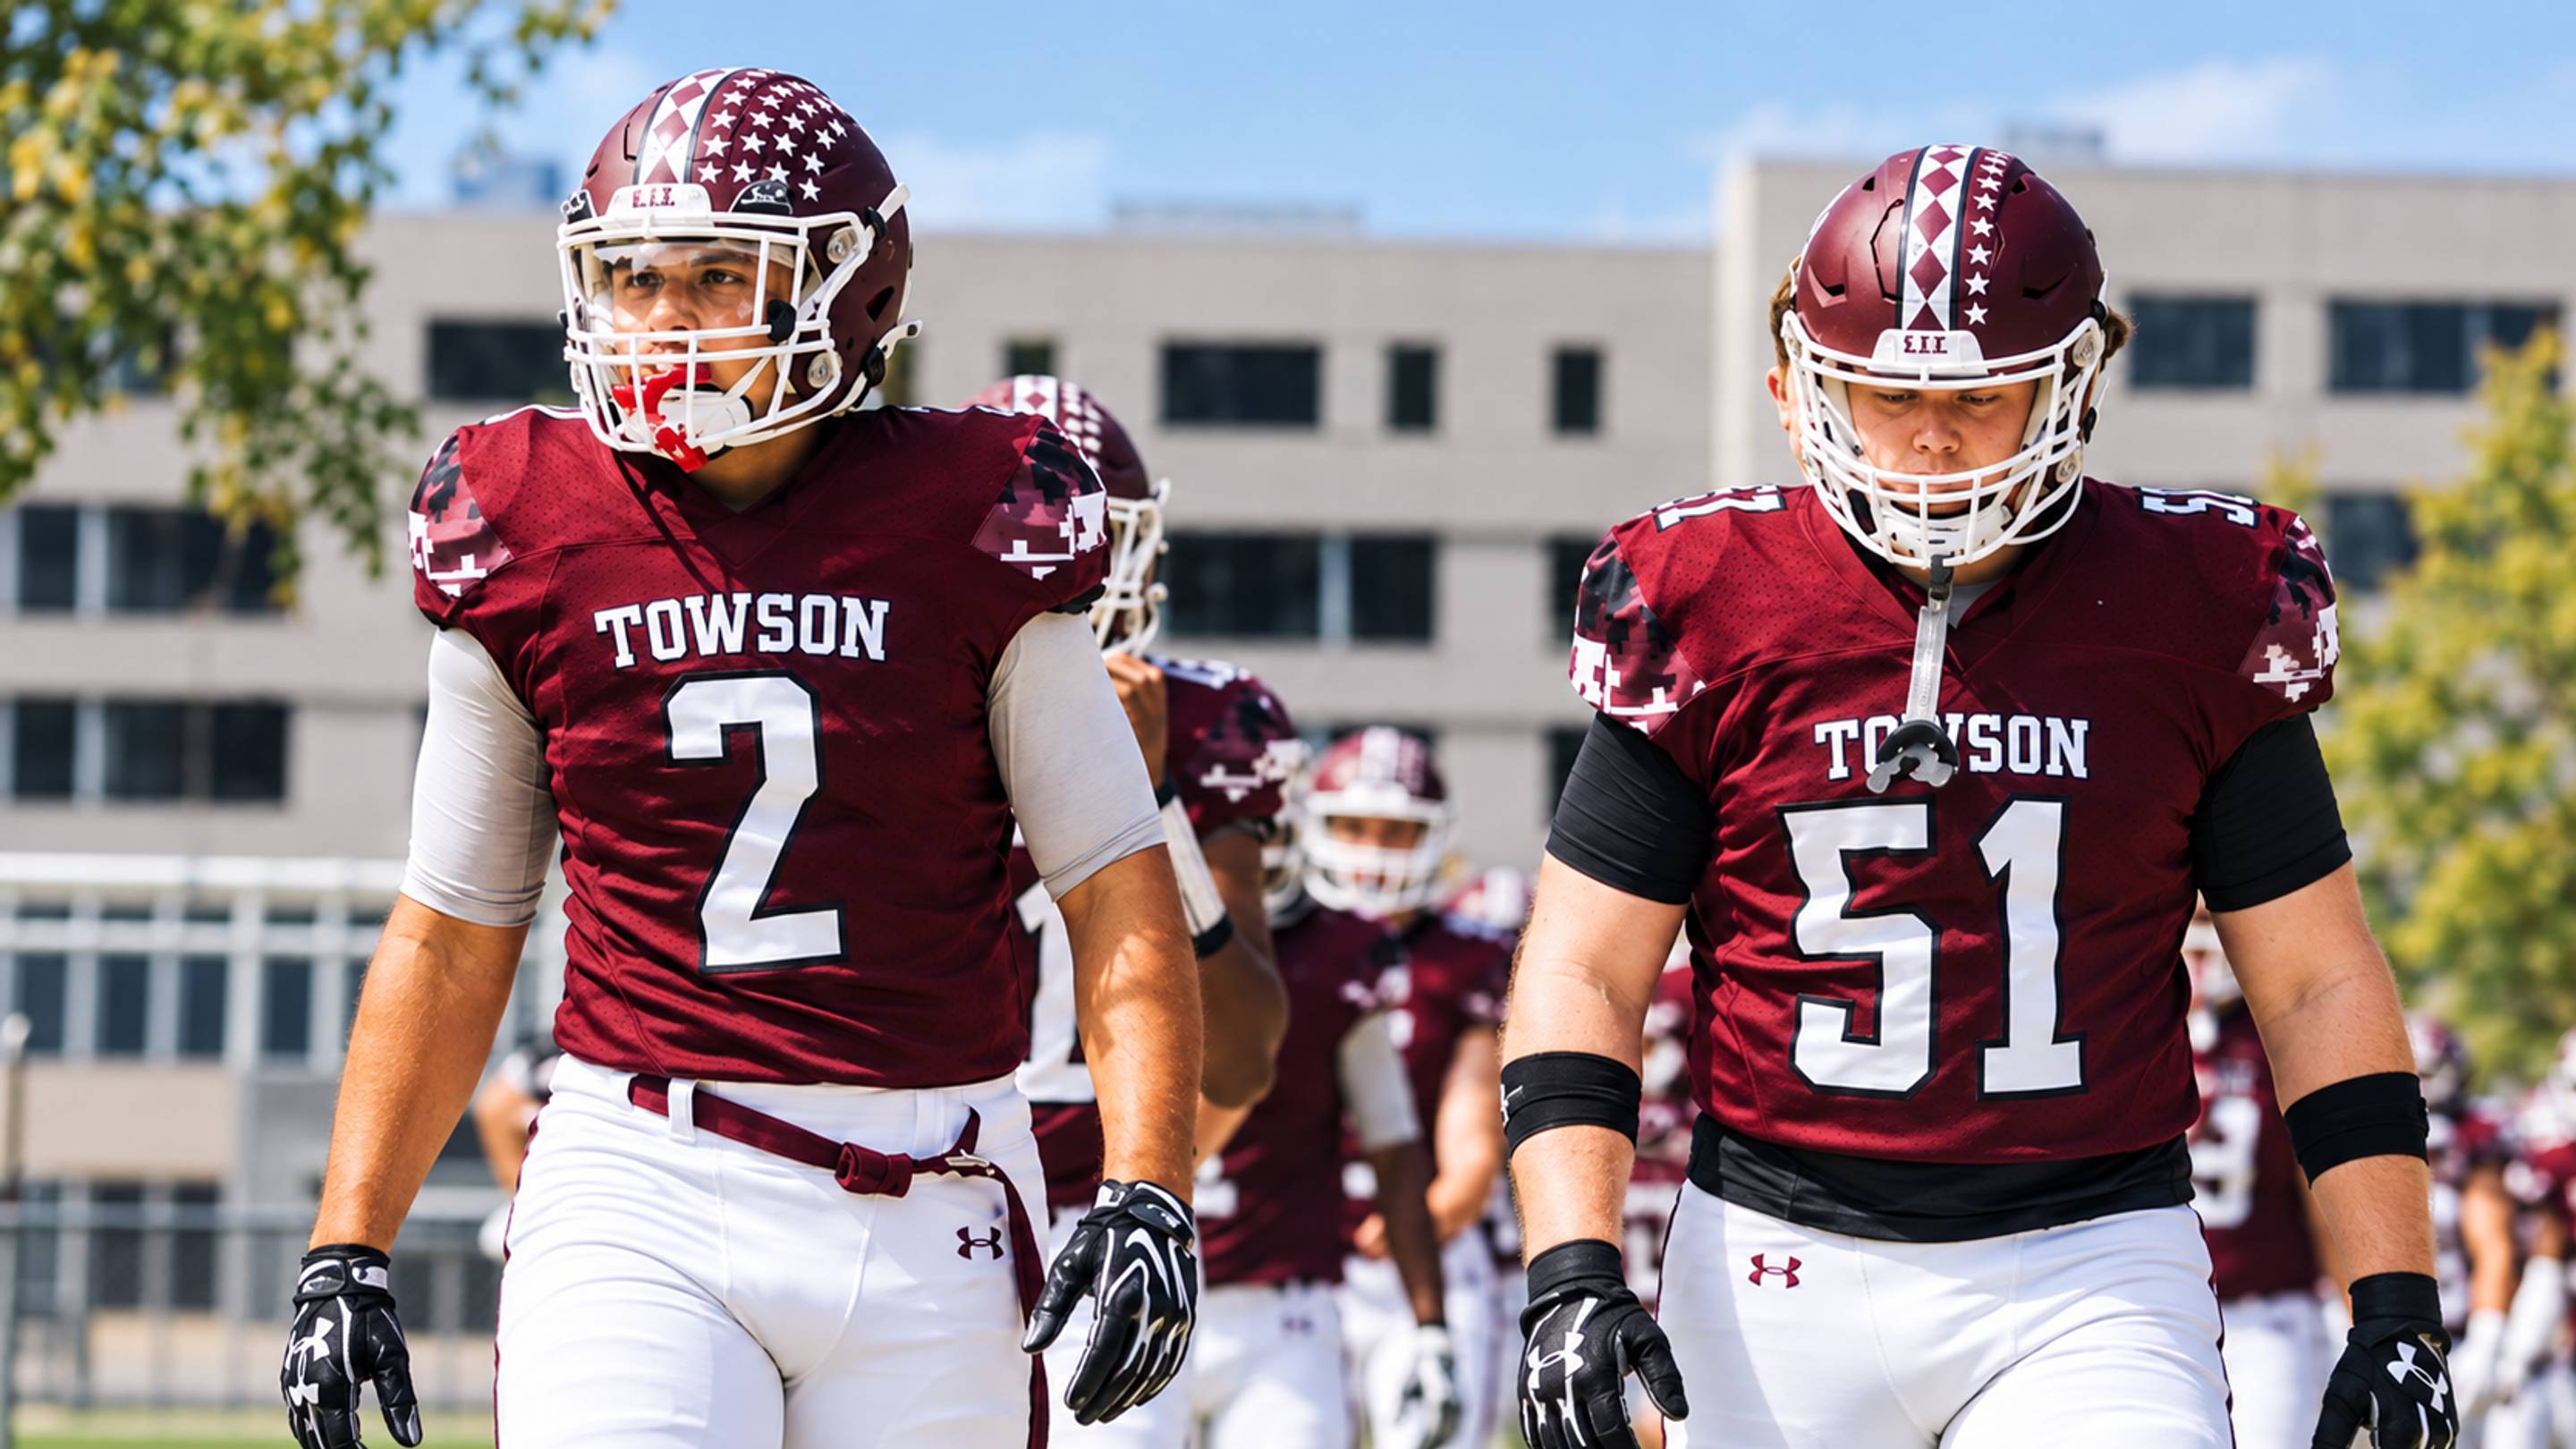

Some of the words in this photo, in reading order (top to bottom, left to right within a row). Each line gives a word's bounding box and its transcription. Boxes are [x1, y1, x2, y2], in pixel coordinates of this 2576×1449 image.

[593, 591, 890, 669] TOWSON
[662, 669, 848, 973] 2
[1813, 712, 2090, 780] TOSON
[1776, 793, 2089, 1101] 51
